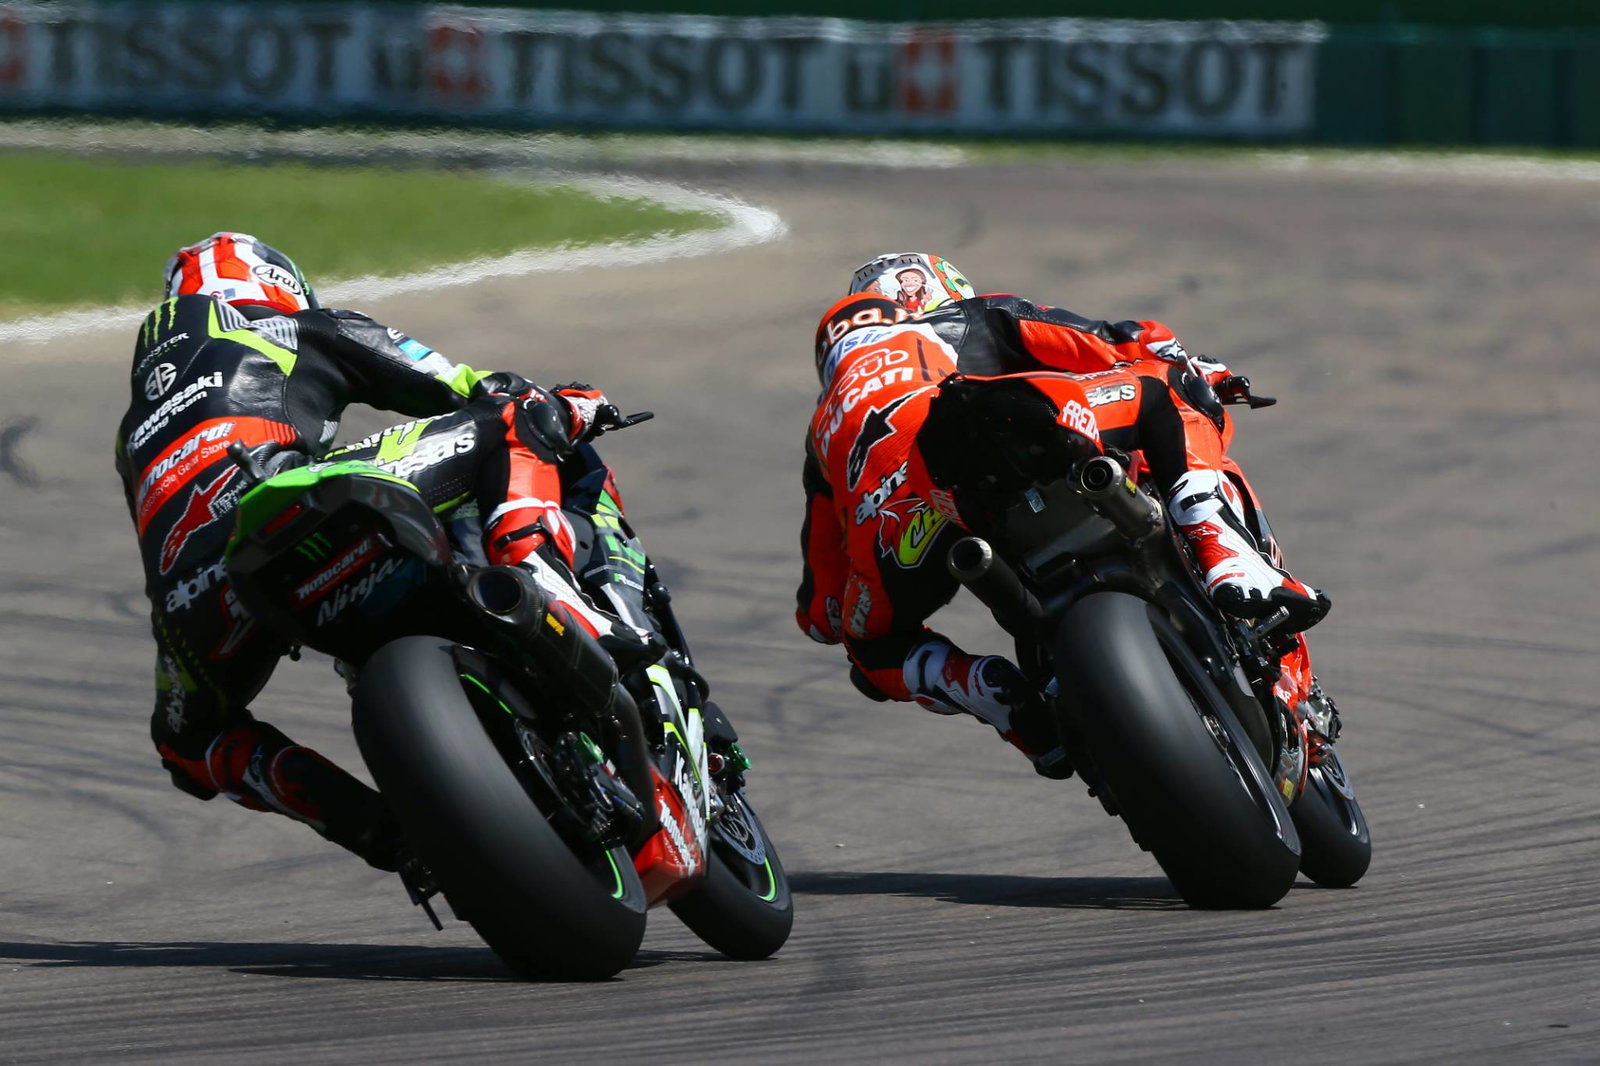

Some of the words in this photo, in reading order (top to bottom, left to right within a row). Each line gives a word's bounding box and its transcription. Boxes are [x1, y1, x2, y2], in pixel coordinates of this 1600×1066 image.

[47, 20, 350, 95] TISSOT
[500, 32, 823, 112] TISSOT
[974, 37, 1300, 117] TISSOT
[257, 268, 298, 291] Arai
[170, 391, 208, 416] Team
[821, 367, 914, 459] DUCATI
[200, 440, 231, 459] Store
[316, 558, 404, 627] Ninja
